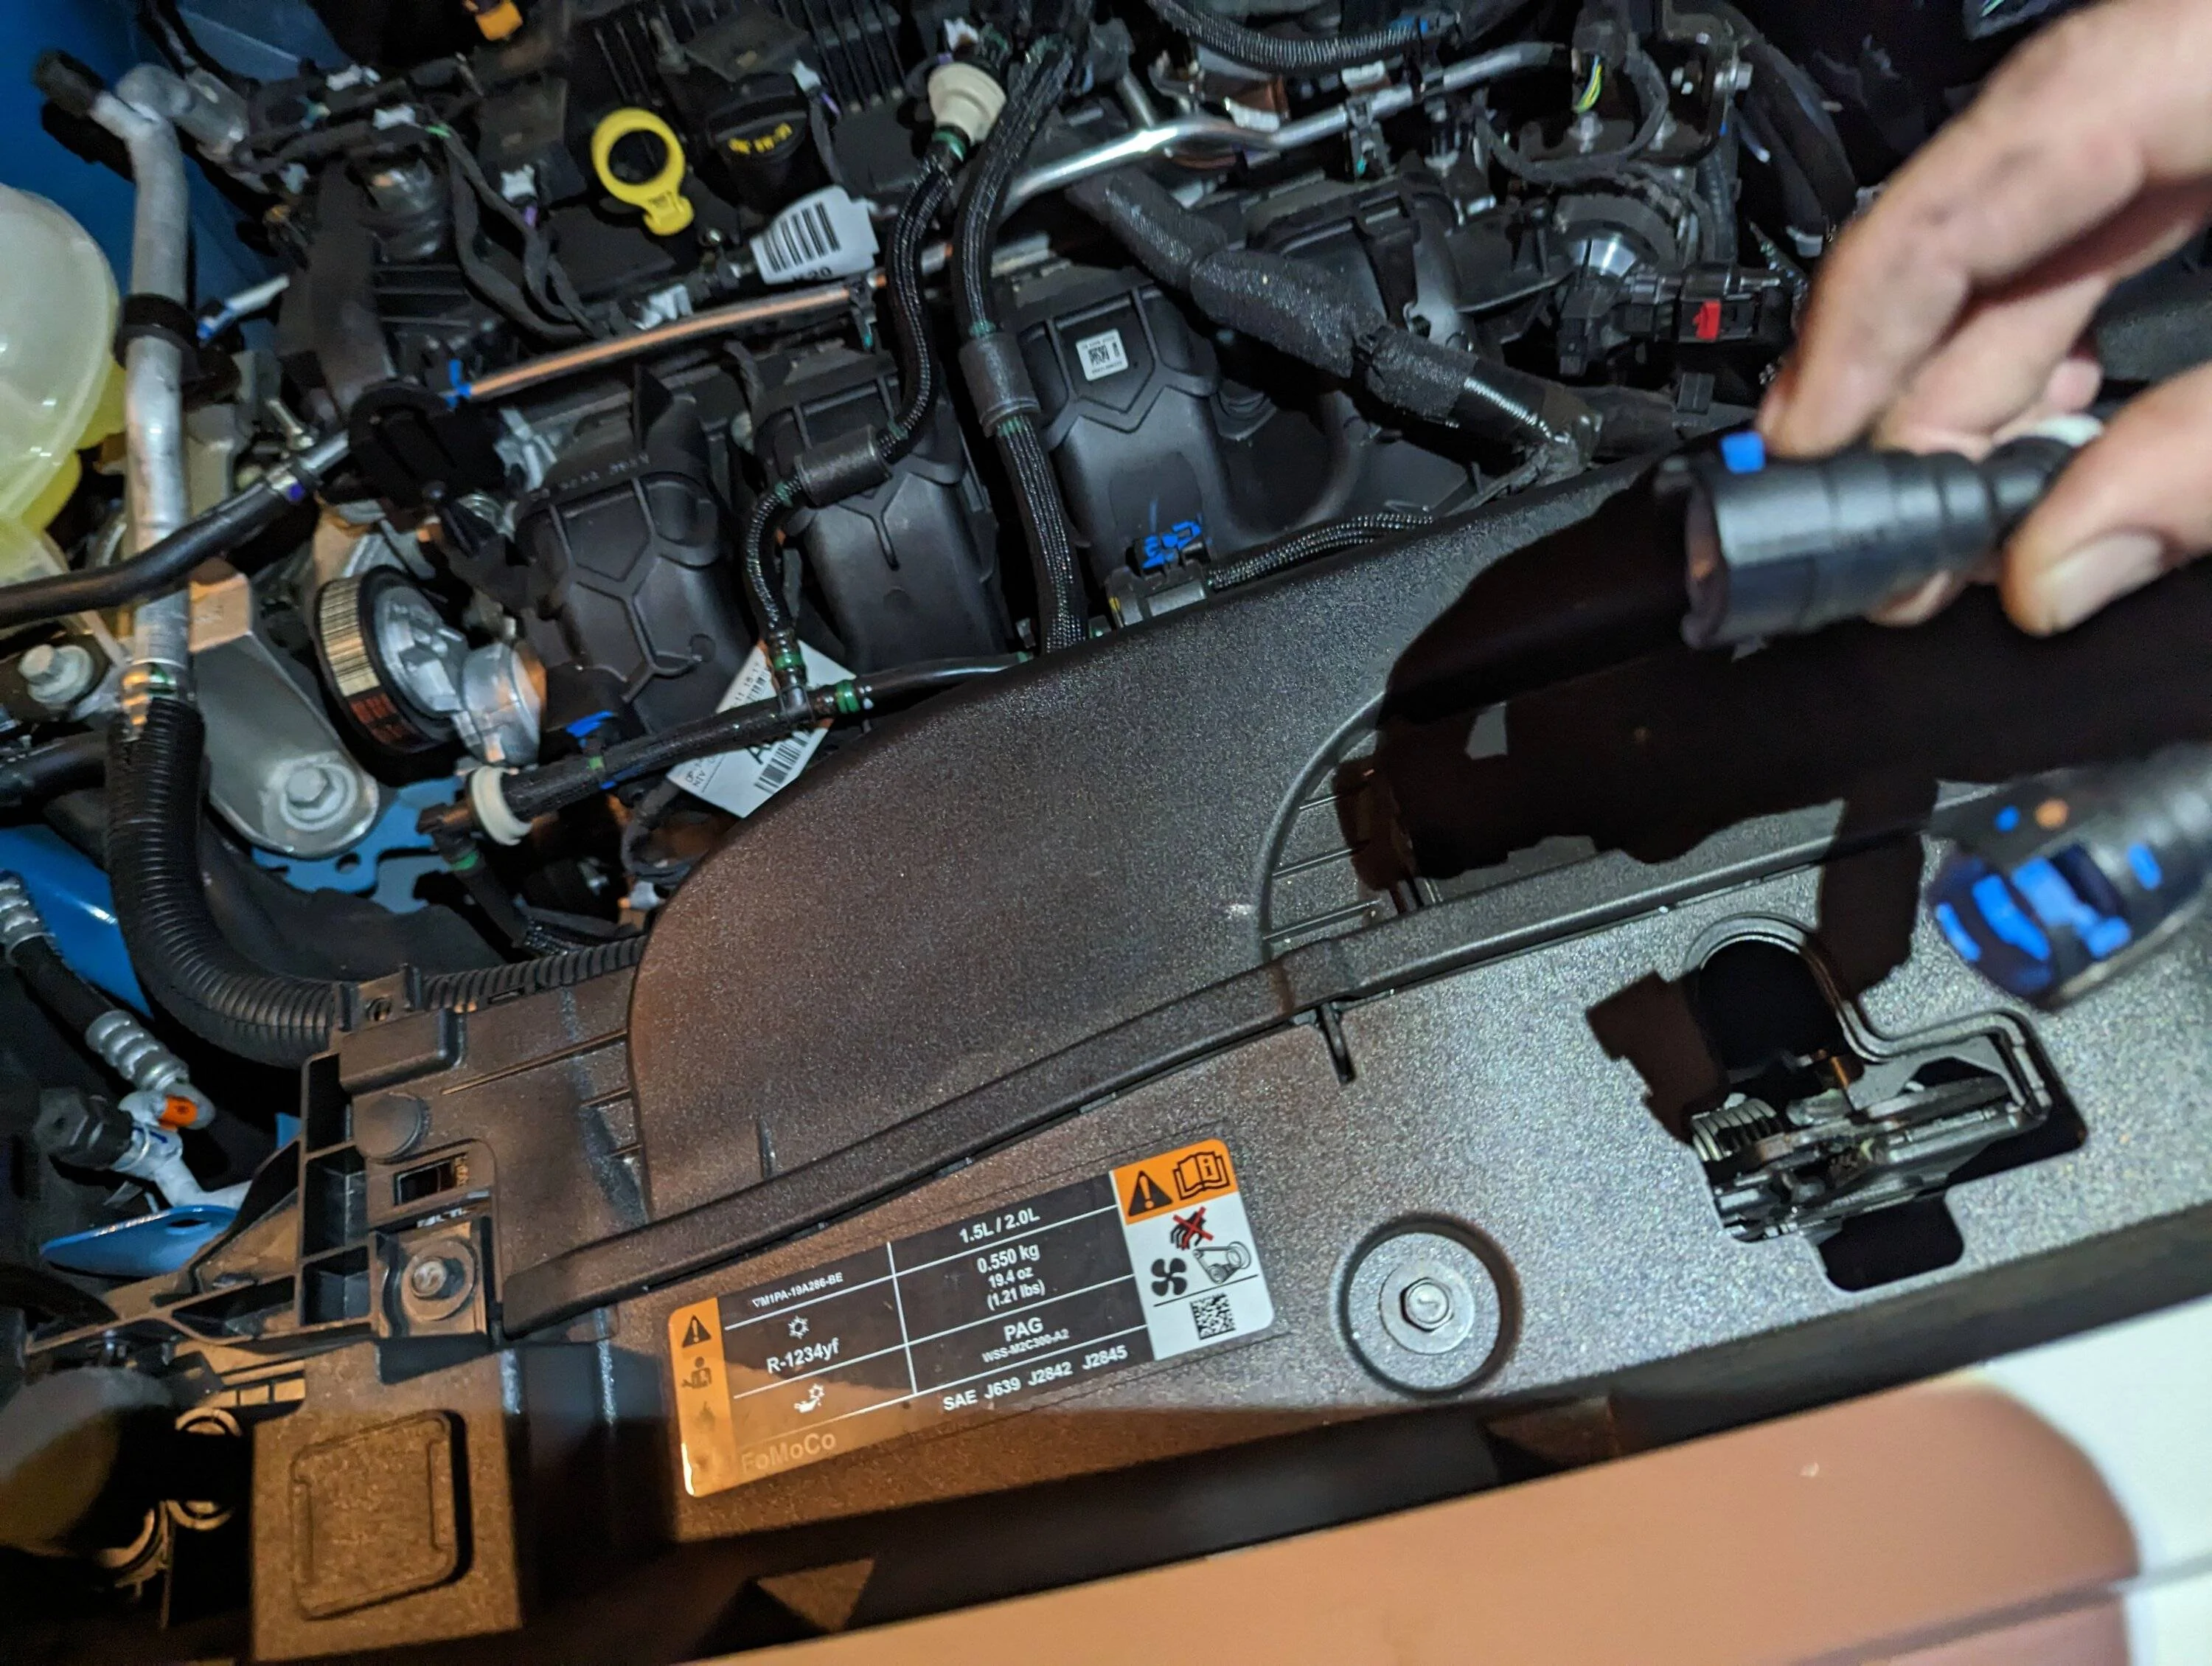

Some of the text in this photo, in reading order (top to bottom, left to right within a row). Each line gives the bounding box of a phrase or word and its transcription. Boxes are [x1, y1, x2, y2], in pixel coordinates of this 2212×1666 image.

[960, 1207, 1040, 1243] 1.5L / 2.0L
[976, 1244, 1040, 1274] 0.550 kg
[988, 1266, 1034, 1288] 19.4 oz
[987, 1279, 1046, 1311] (1.21 lbs)
[1004, 1316, 1044, 1342] PAG
[766, 1337, 839, 1374] R-1234yf
[943, 1344, 1128, 1411] SAE J639 J2842 J2845
[741, 1432, 837, 1473] FoMoCo
